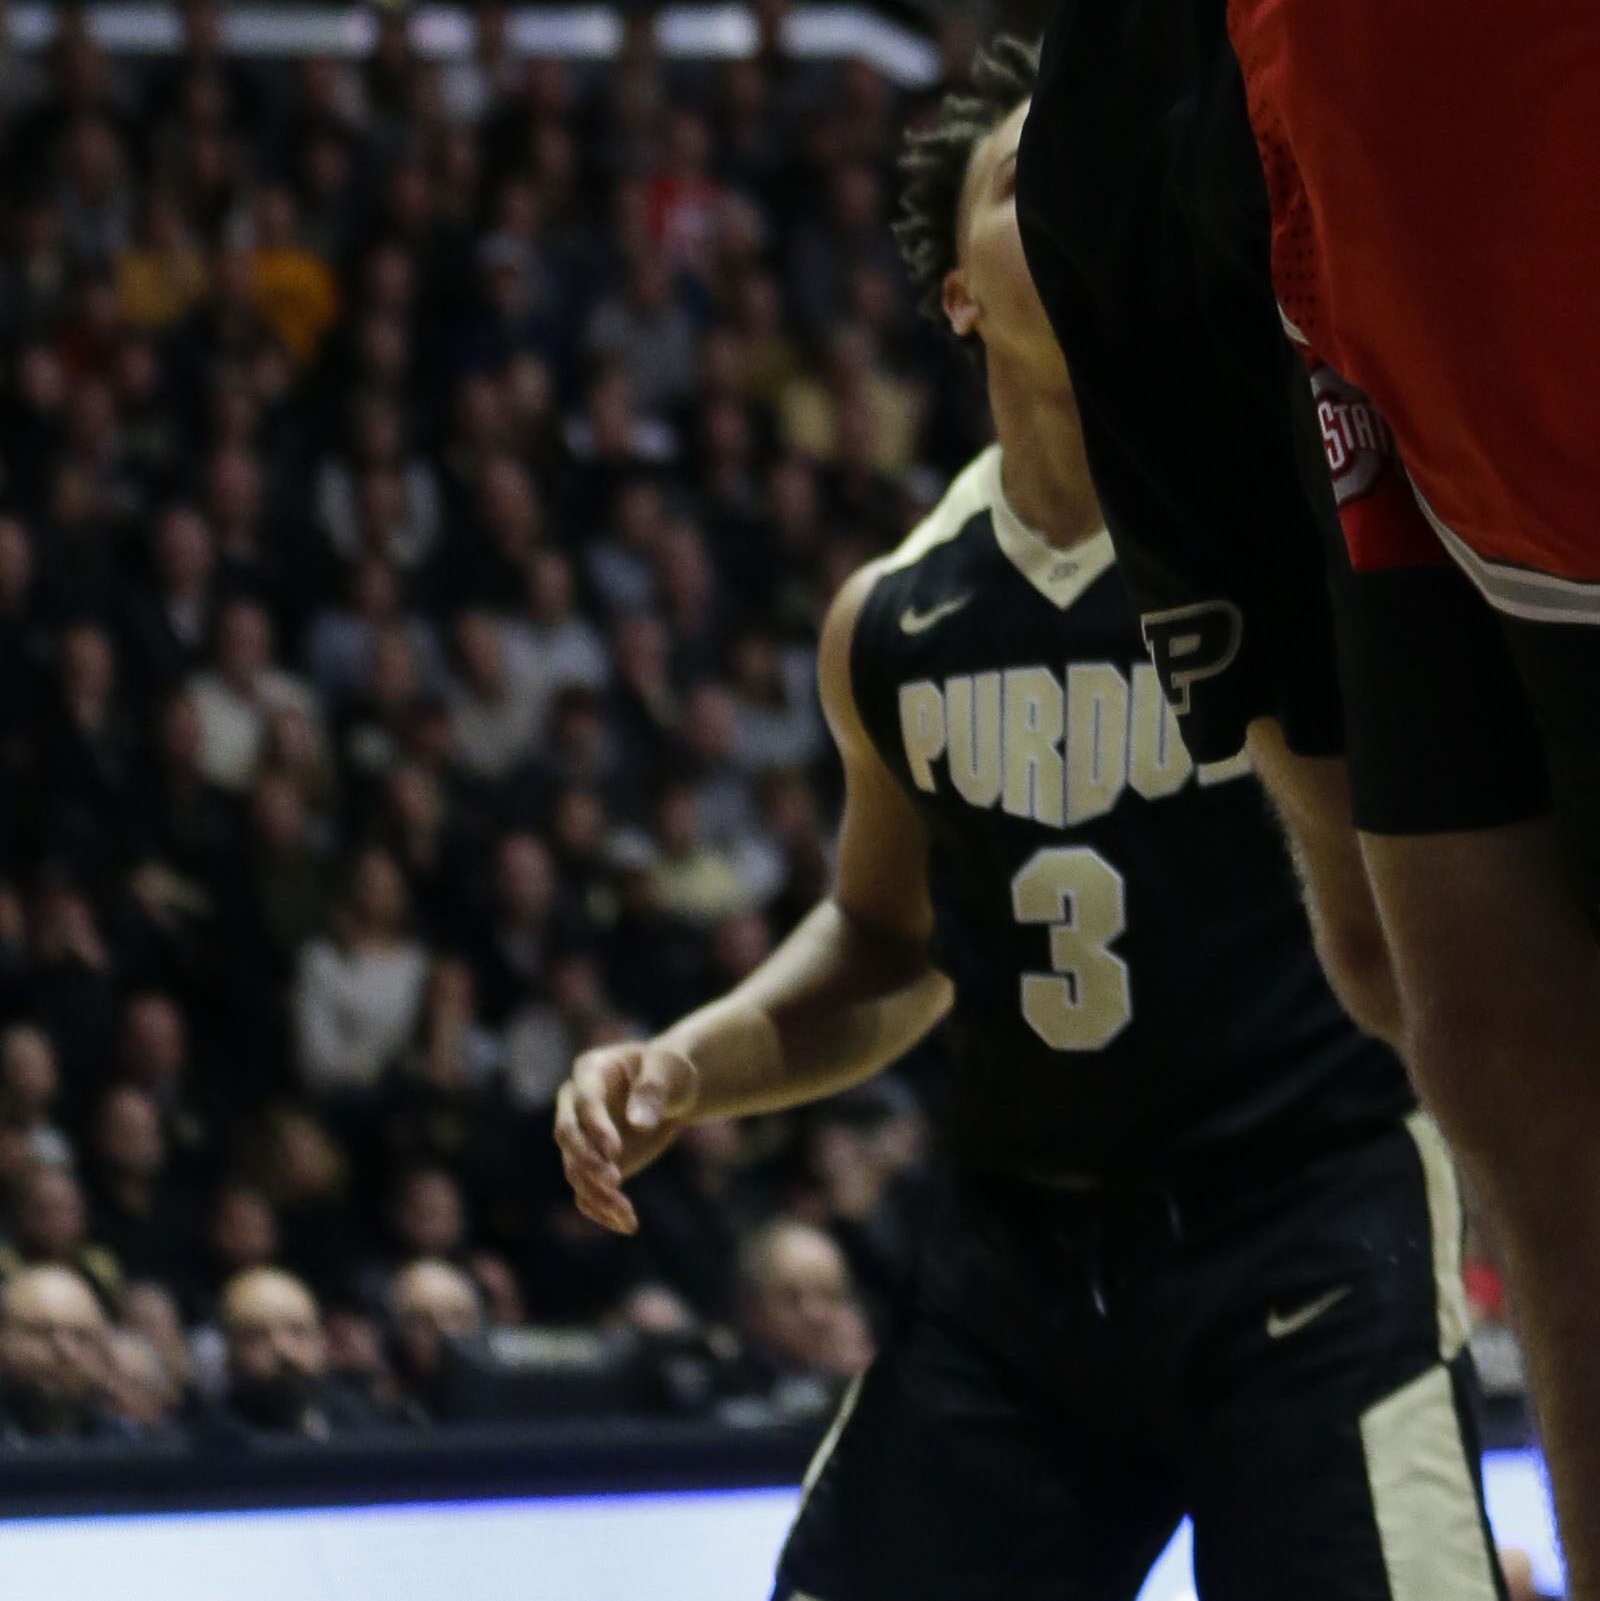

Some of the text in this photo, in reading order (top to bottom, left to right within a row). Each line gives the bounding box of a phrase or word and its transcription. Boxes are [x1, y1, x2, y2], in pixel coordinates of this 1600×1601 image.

[1317, 398, 1389, 472] STAT
[898, 660, 1196, 830] PURDU
[1010, 844, 1134, 1053] 3
